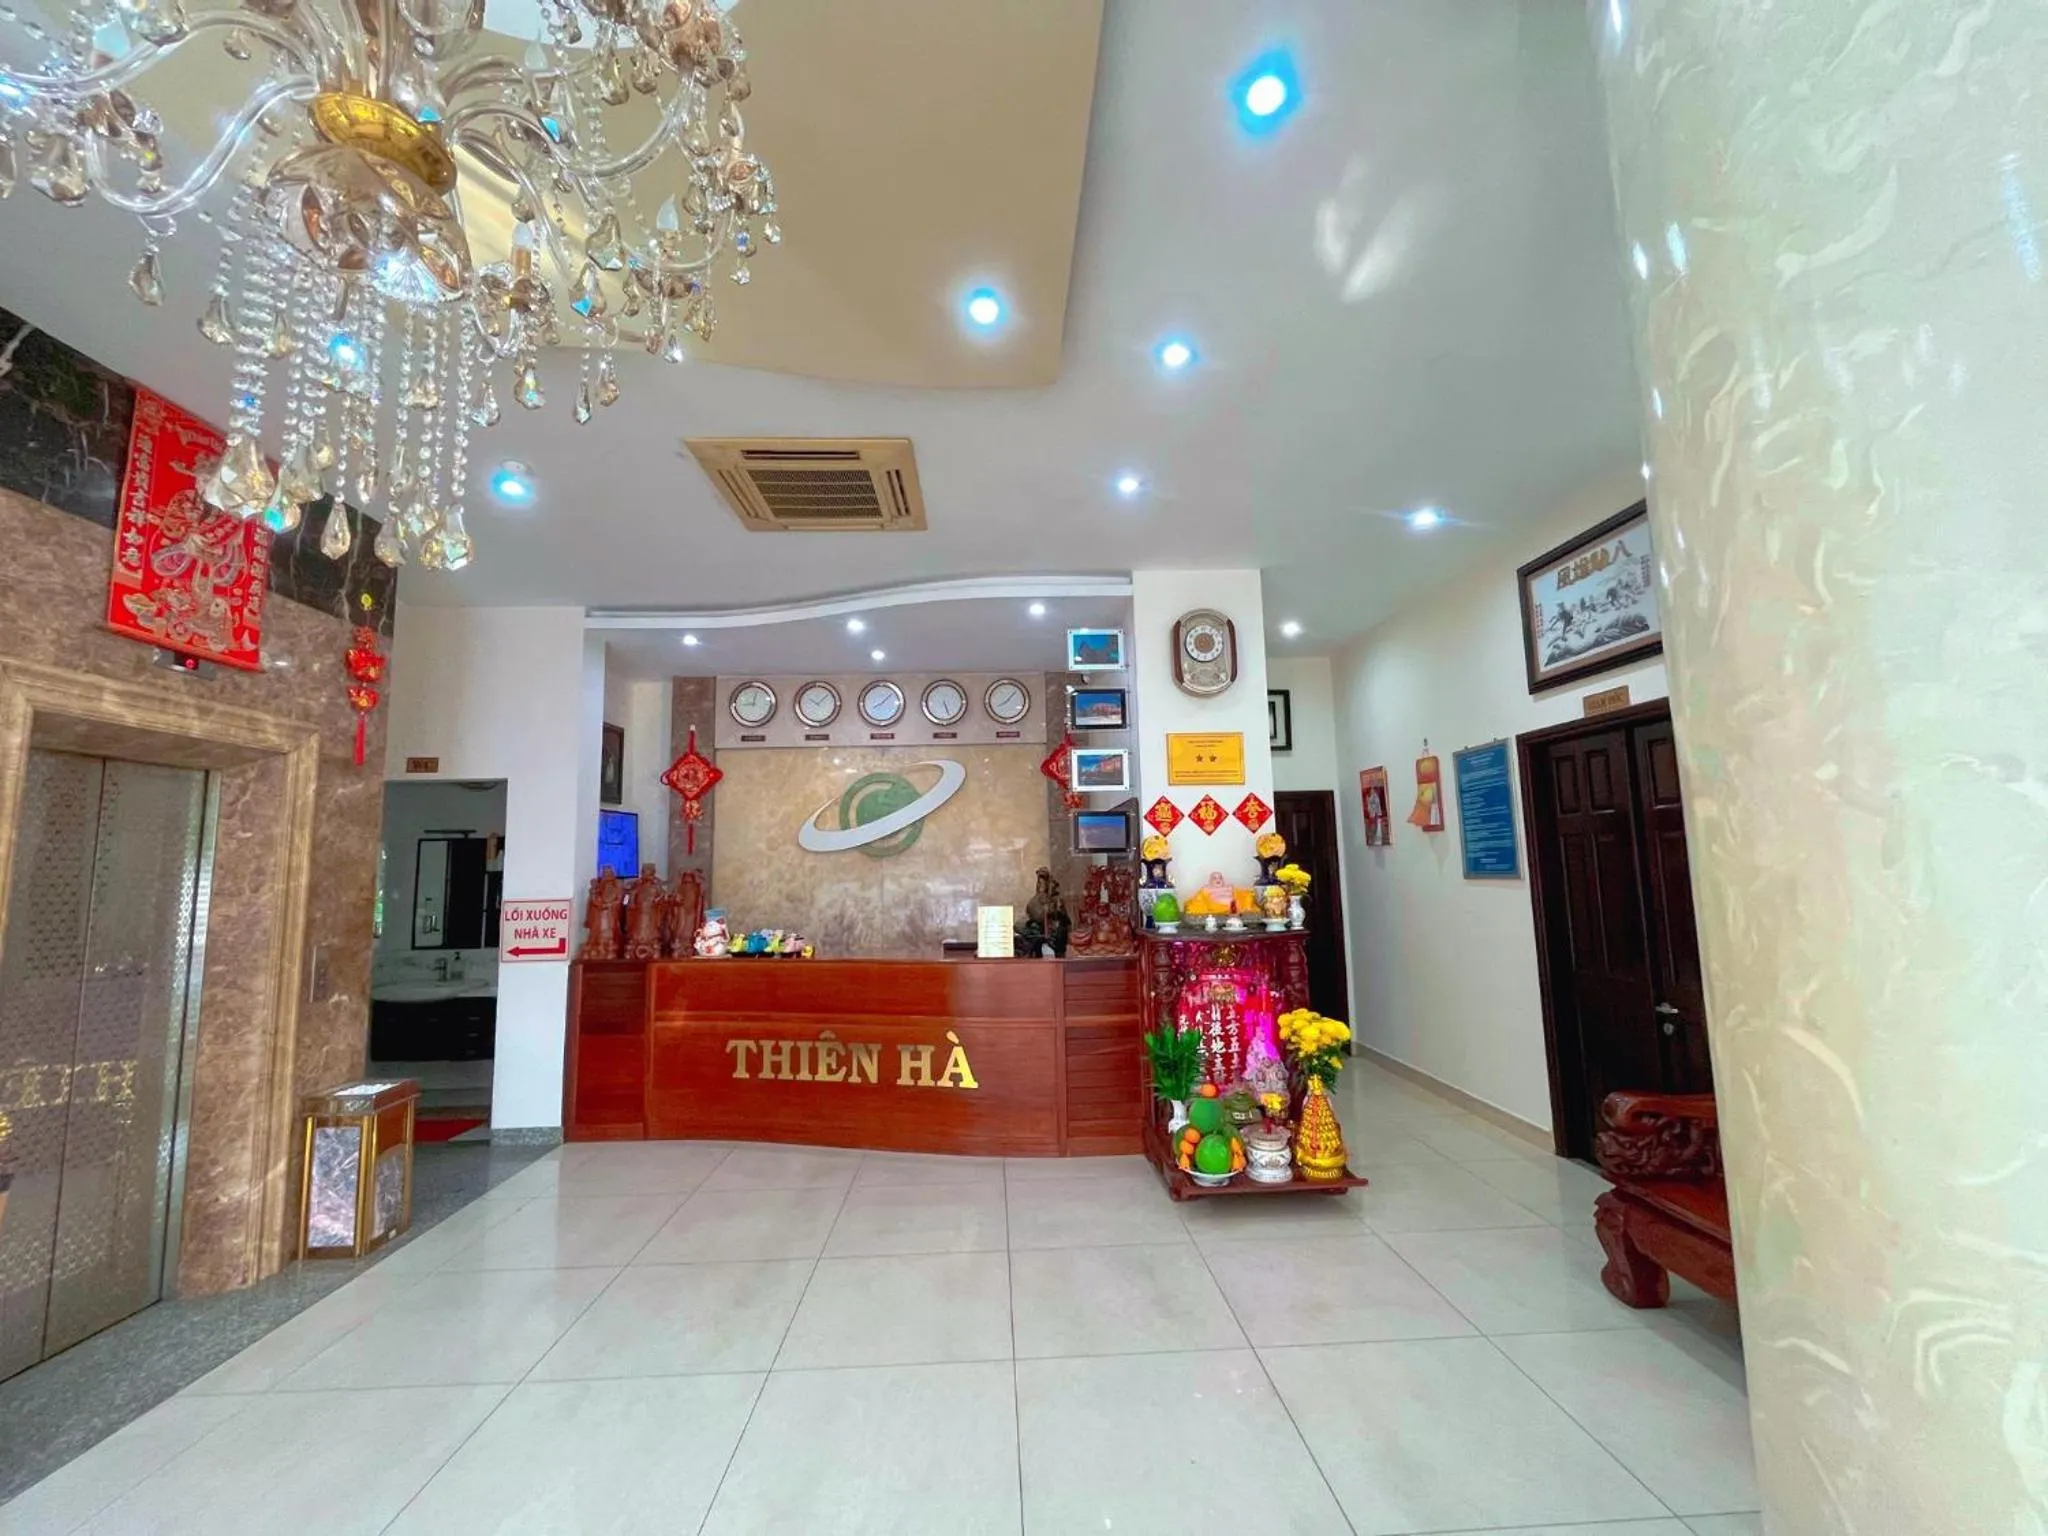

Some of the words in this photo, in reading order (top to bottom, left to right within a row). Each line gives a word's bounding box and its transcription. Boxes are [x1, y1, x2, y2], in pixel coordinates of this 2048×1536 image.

[504, 906, 524, 921] LỐI
[526, 905, 568, 920] XUỐNG
[514, 925, 539, 939] NHÀ
[542, 928, 556, 938] XE
[725, 1030, 882, 1084] THIÊN
[896, 1030, 979, 1089] HÀ
